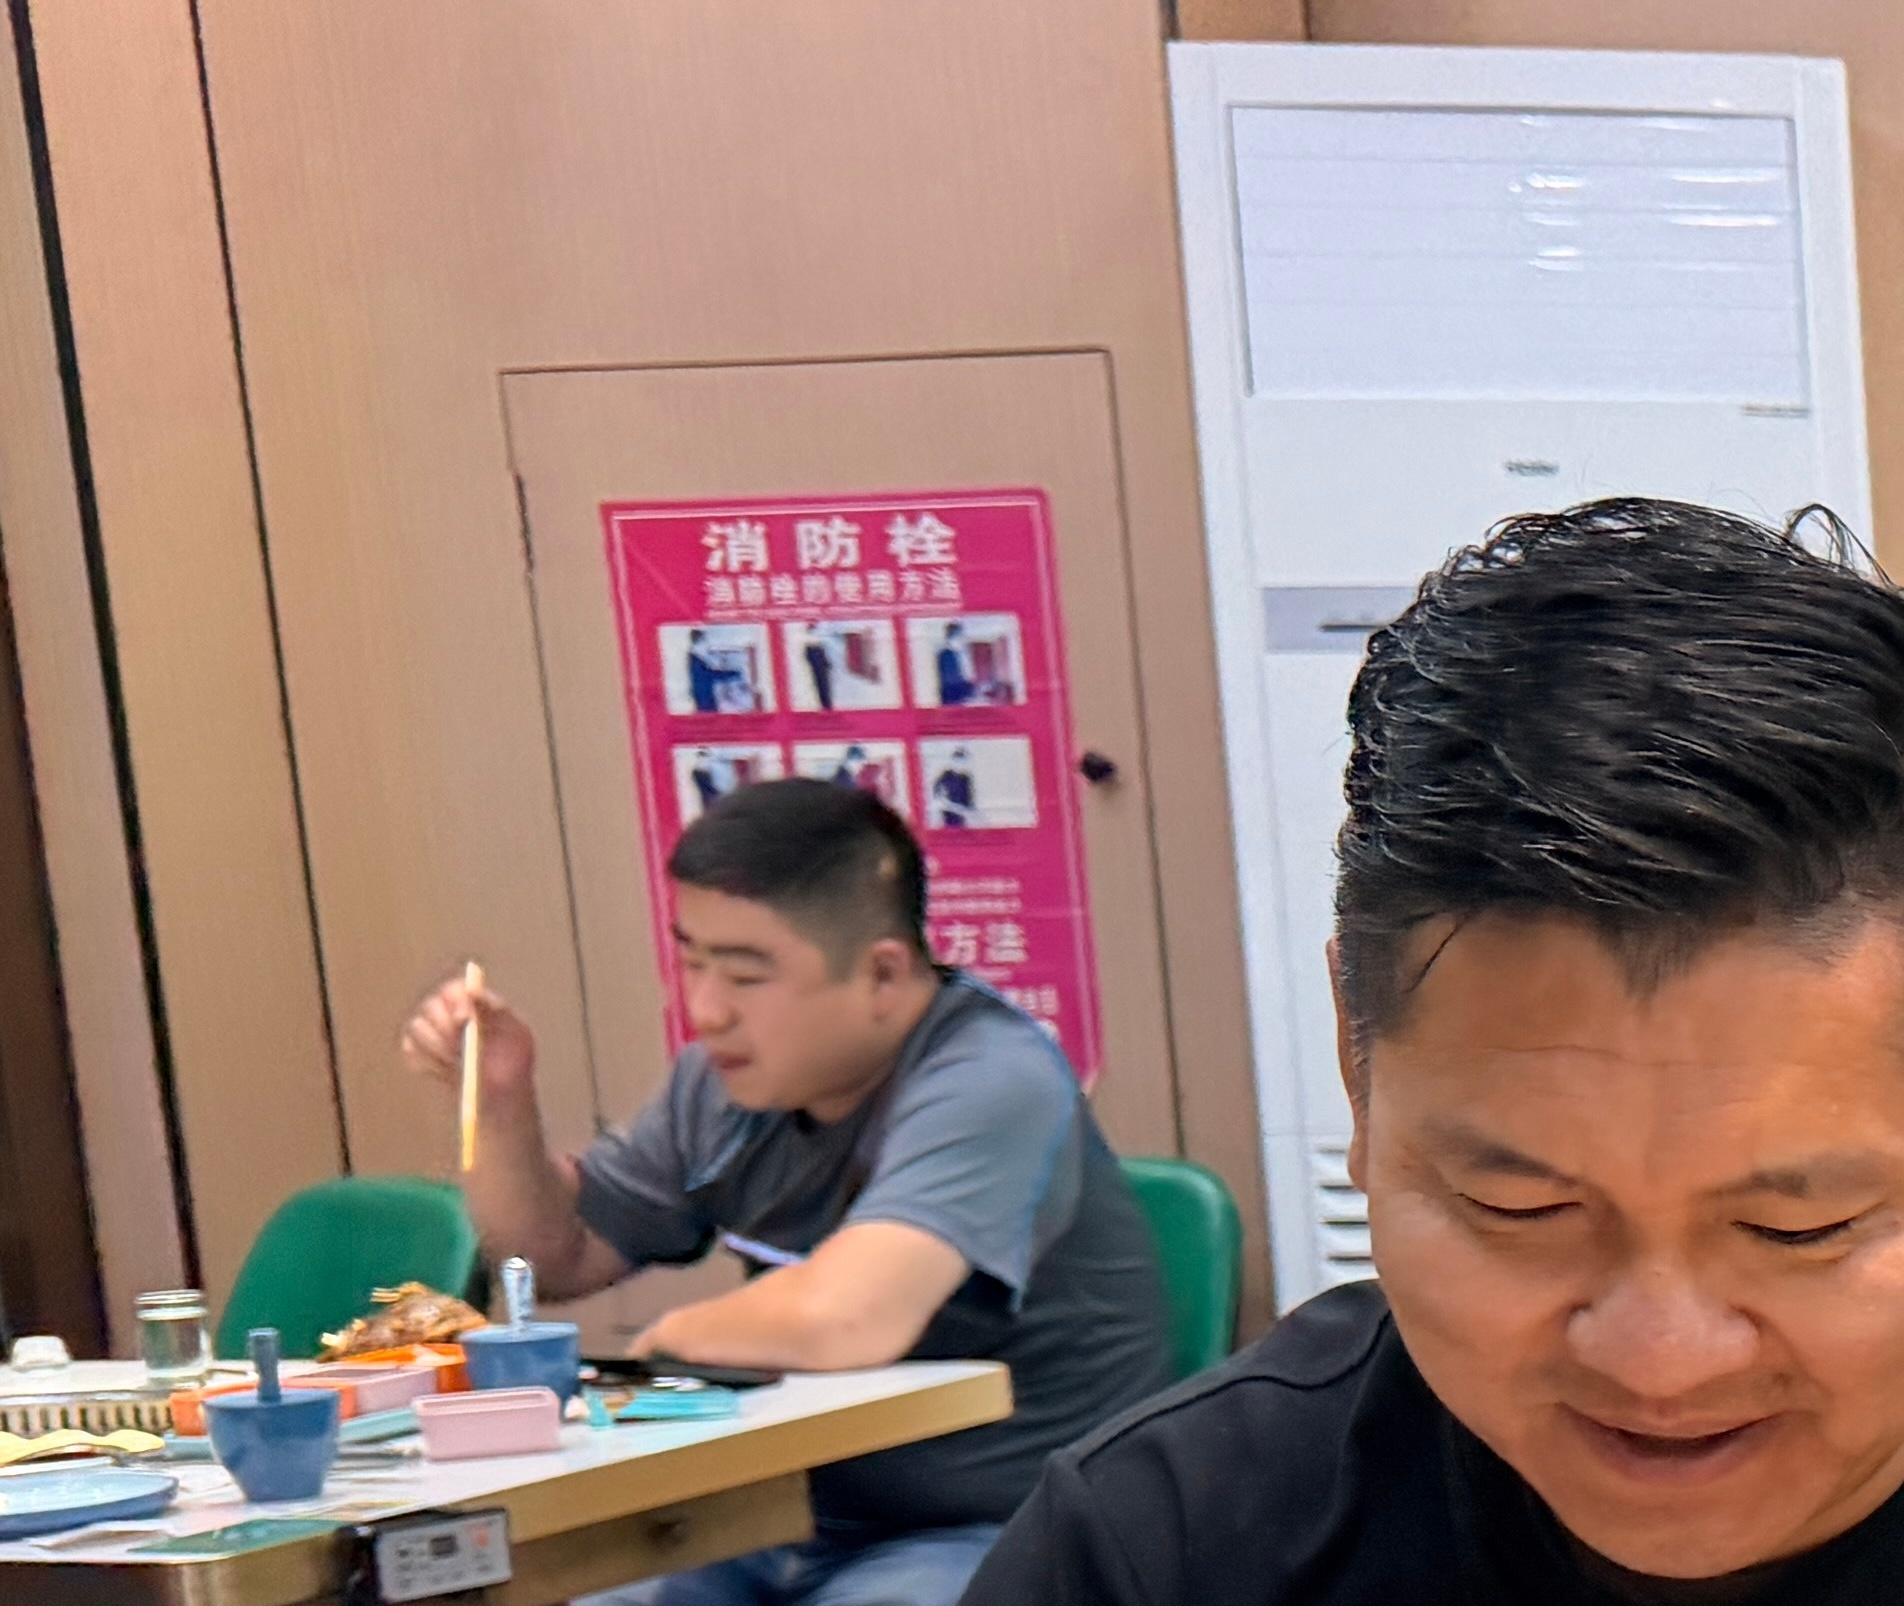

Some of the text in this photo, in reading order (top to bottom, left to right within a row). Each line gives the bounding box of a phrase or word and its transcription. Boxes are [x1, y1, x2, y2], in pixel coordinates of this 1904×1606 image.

[702, 511, 958, 573] 消防栓
[704, 568, 962, 607] 消防栓的使用方法
